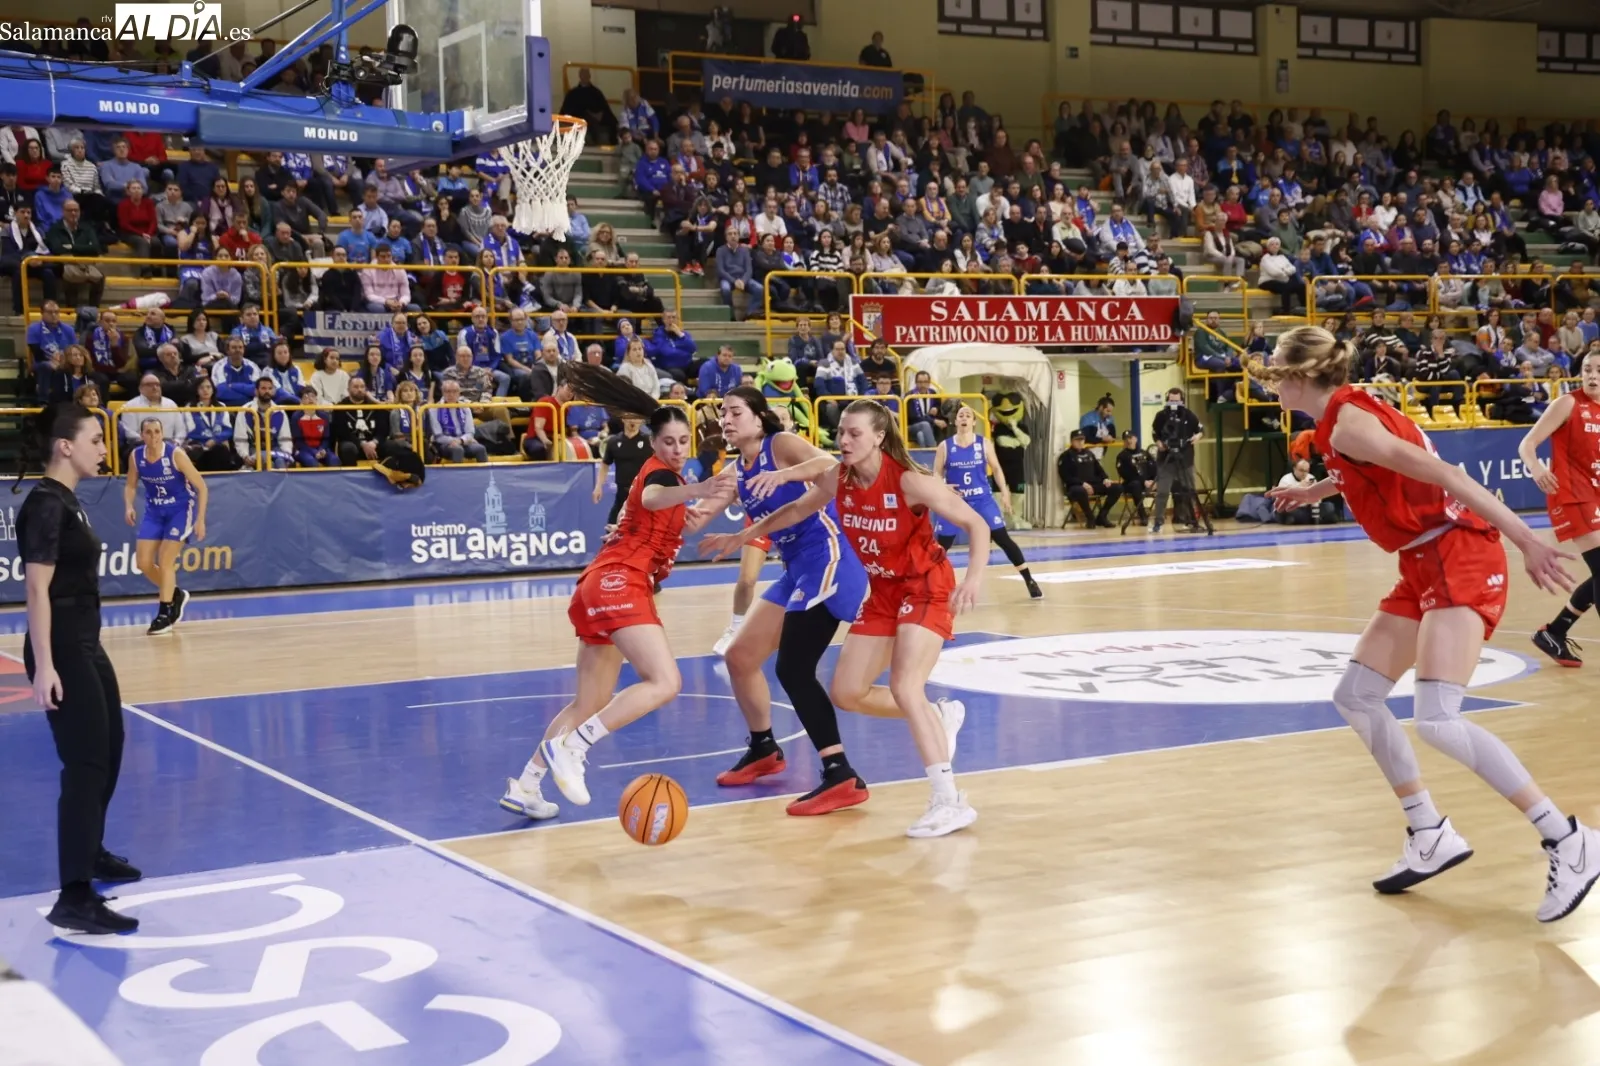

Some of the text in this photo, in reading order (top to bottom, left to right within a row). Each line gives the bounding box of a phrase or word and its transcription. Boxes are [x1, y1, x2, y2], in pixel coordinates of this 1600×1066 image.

[99, 100, 160, 115] MONDO
[303, 126, 359, 142] MONDO
[930, 300, 1145, 322] SALAMANCA
[895, 324, 1171, 343] PATRIMONIO DE LA HUMANIDAD
[963, 471, 972, 485] 6
[411, 521, 466, 538] turismo
[857, 536, 881, 556] 24
